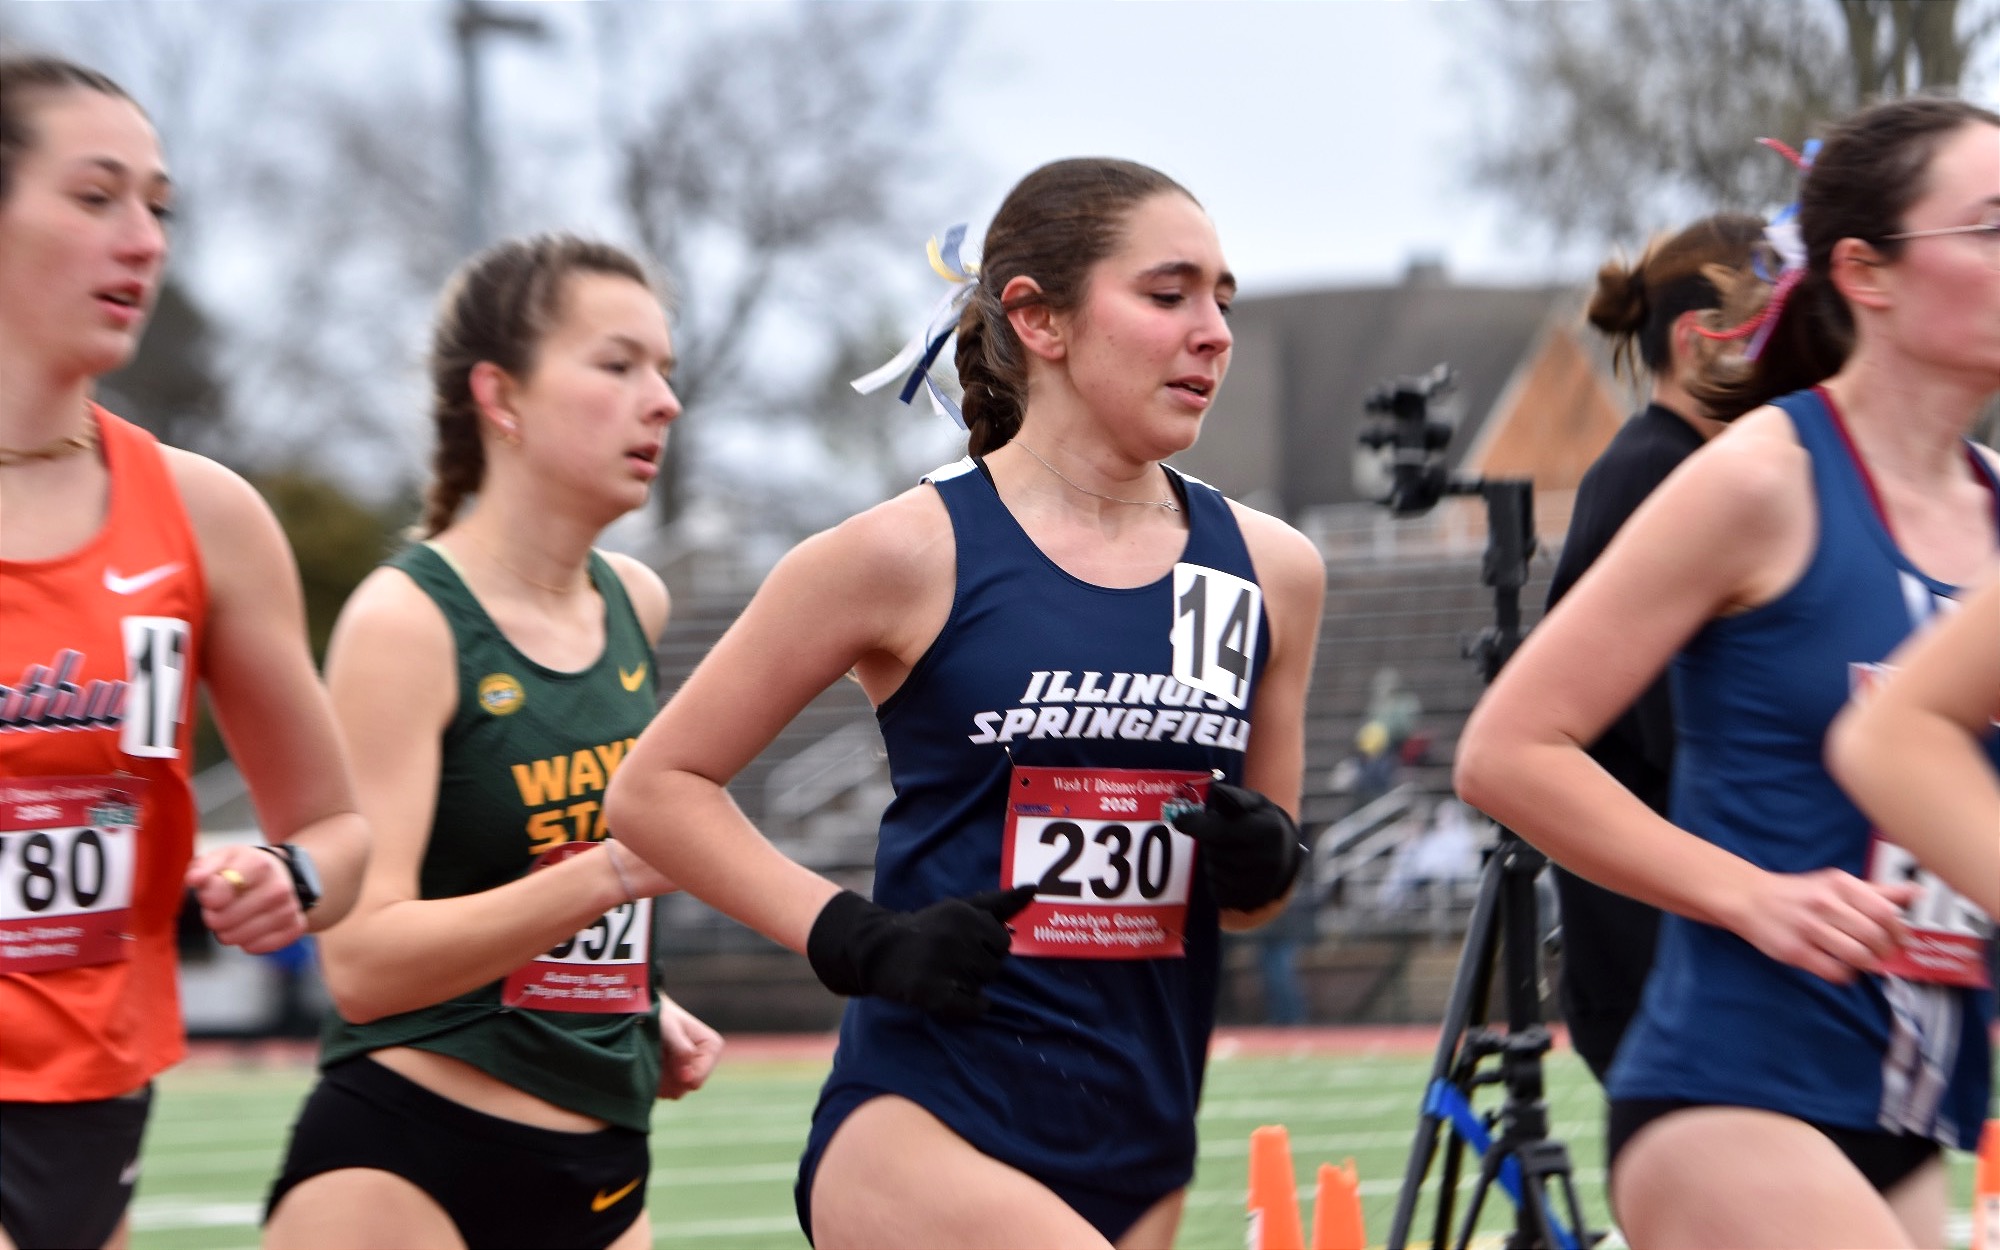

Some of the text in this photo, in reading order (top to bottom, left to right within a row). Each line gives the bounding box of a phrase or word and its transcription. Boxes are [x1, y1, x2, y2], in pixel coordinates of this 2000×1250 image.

[1178, 573, 1252, 703] 14
[511, 737, 641, 807] WAY
[0, 828, 106, 913] 80
[1037, 820, 1173, 900] 230
